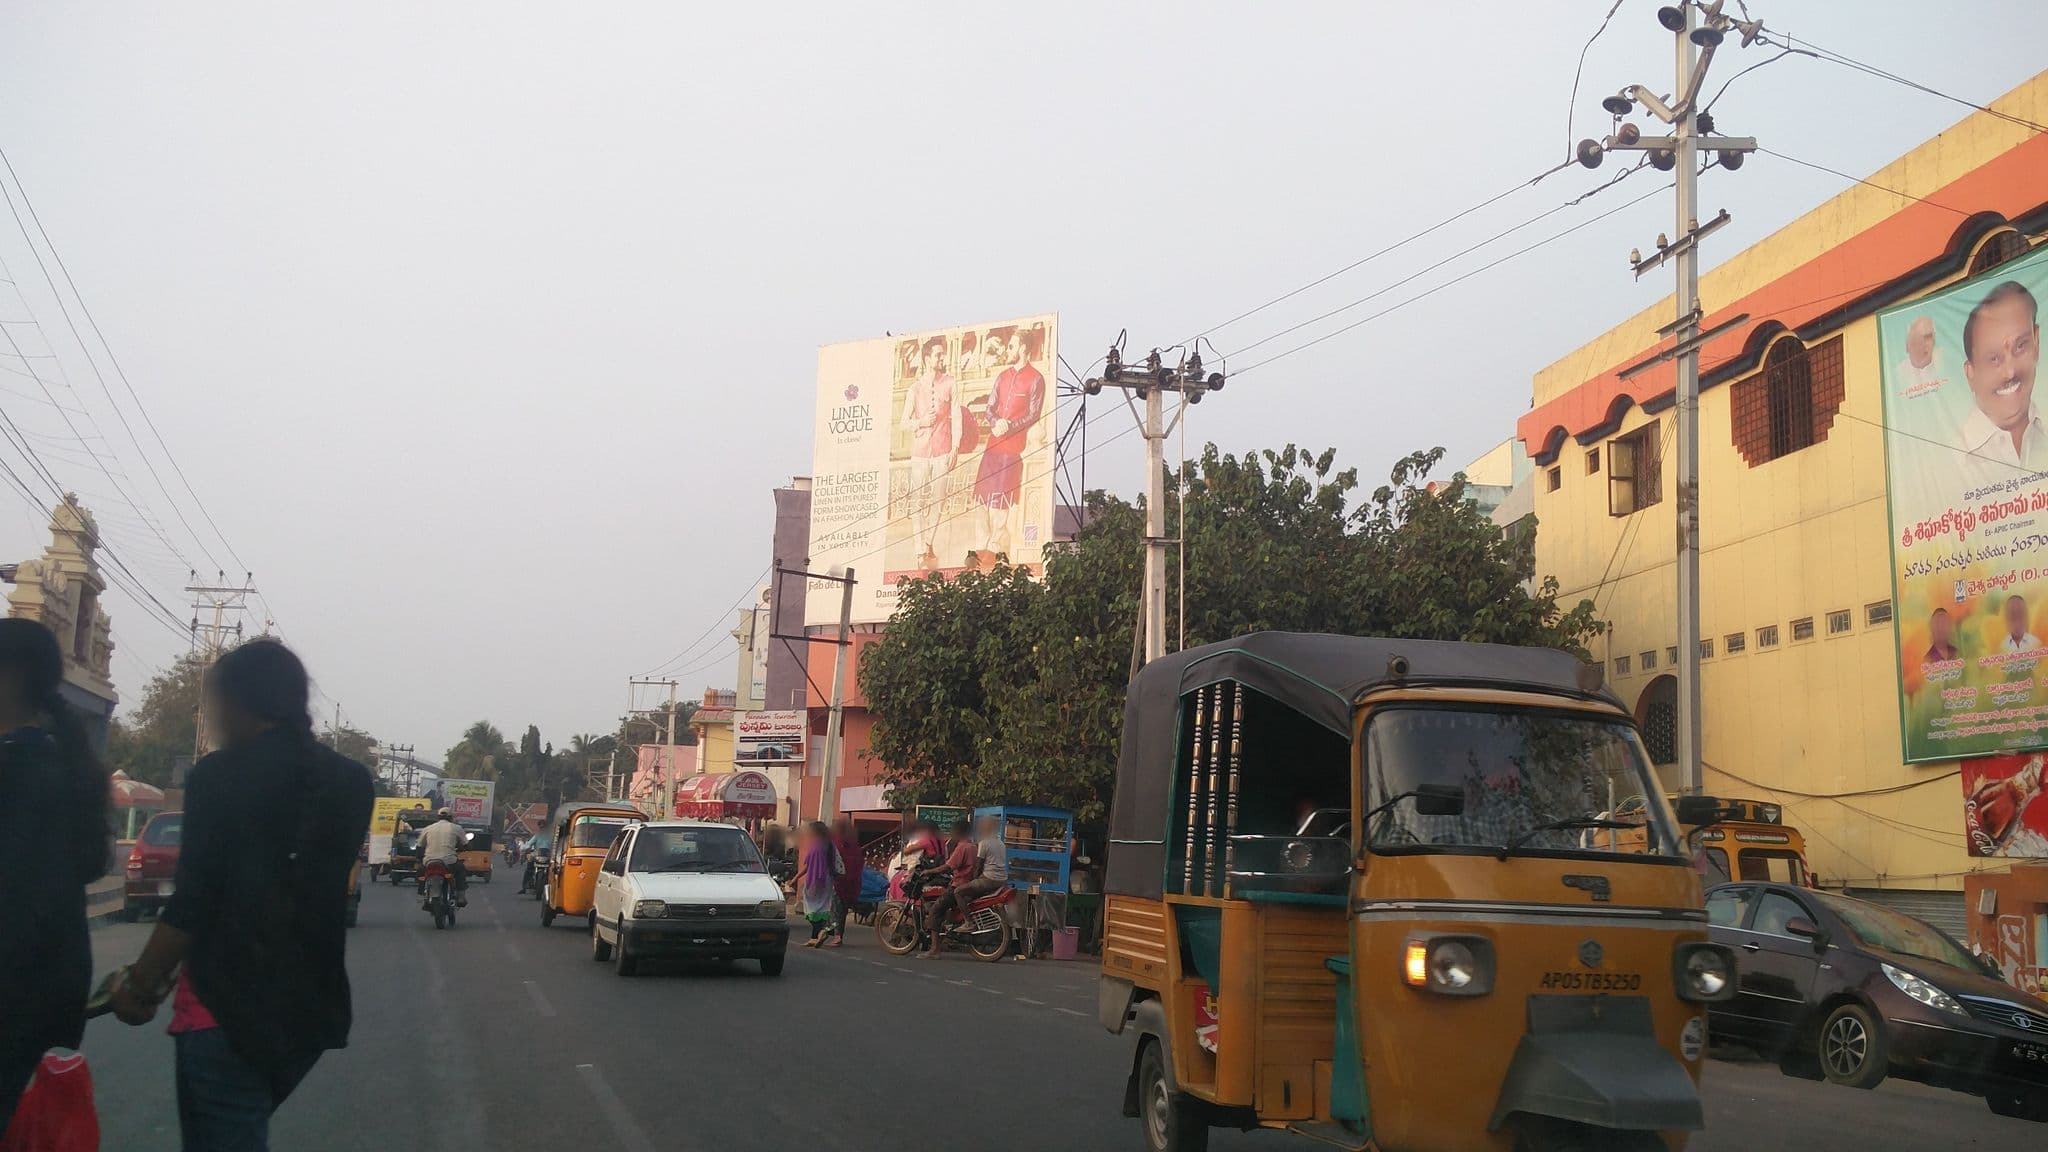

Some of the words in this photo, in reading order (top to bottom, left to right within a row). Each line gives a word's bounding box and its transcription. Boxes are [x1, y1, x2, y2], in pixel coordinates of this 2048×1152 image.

[832, 404, 870, 421] LINEN
[828, 418, 873, 434] VOGUE
[815, 474, 834, 487] THE
[836, 471, 880, 485] LARGEST
[814, 483, 866, 497] COLLECTION
[867, 482, 879, 492] OF
[819, 530, 869, 541] AVAILABLE
[1541, 971, 1642, 991] AP05TB5250
